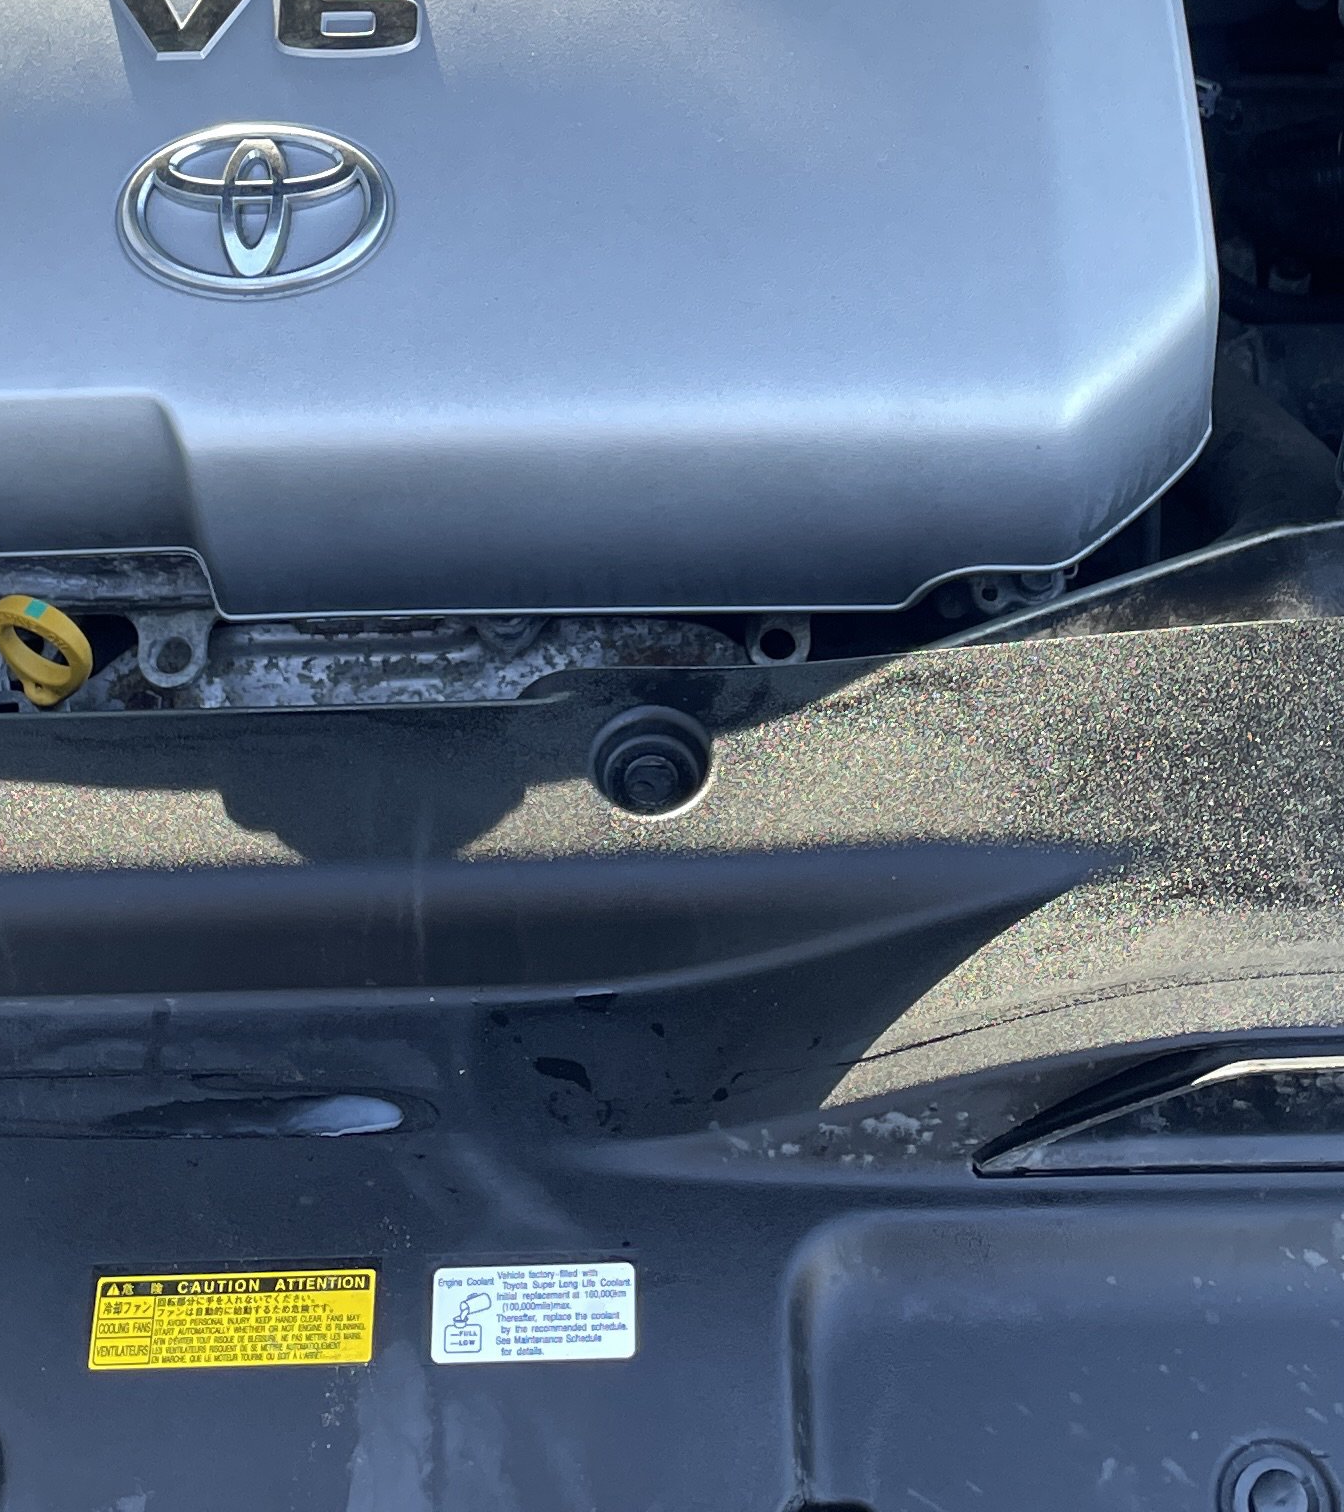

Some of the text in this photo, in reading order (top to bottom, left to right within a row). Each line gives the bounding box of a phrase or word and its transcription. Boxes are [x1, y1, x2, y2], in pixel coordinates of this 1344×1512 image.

[497, 1270, 525, 1280] Vehicle
[582, 1269, 598, 1277] with
[177, 1276, 365, 1294] CAUTION ATTENTION
[438, 1277, 494, 1288] Engine Coolant
[503, 1281, 528, 1291] Toyota
[532, 1280, 556, 1290] Super
[559, 1280, 578, 1290] Long
[582, 1278, 596, 1288] Life
[496, 1291, 517, 1301] Initial
[522, 1291, 570, 1301] replacement
[572, 1291, 580, 1299] at
[103, 1301, 152, 1315] 冷却ファン
[155, 1319, 164, 1327] TO
[190, 1317, 224, 1326] PERSONAL
[255, 1316, 272, 1324] KEEP
[276, 1315, 298, 1323] HANDS
[326, 1314, 343, 1322] FANS
[346, 1313, 361, 1322] MAY
[496, 1311, 620, 1323] Thereafter, replace the coolant
[98, 1321, 151, 1334] COOLING FANS
[154, 1328, 174, 1336] START
[177, 1326, 230, 1336] AUTOMATICALLY
[233, 1325, 266, 1333] WHETHER
[268, 1325, 278, 1333] OR
[281, 1324, 295, 1332] NOT
[298, 1323, 323, 1332] ENGINE
[500, 1322, 628, 1335] by the recommended schedule.
[196, 1336, 211, 1344] TOUT
[213, 1335, 236, 1345] RISQUE
[291, 1333, 303, 1342] PAS
[495, 1333, 602, 1345] See Maintenance Schedule
[95, 1345, 149, 1357] VENTILATEURS
[501, 1346, 545, 1356] for details.
